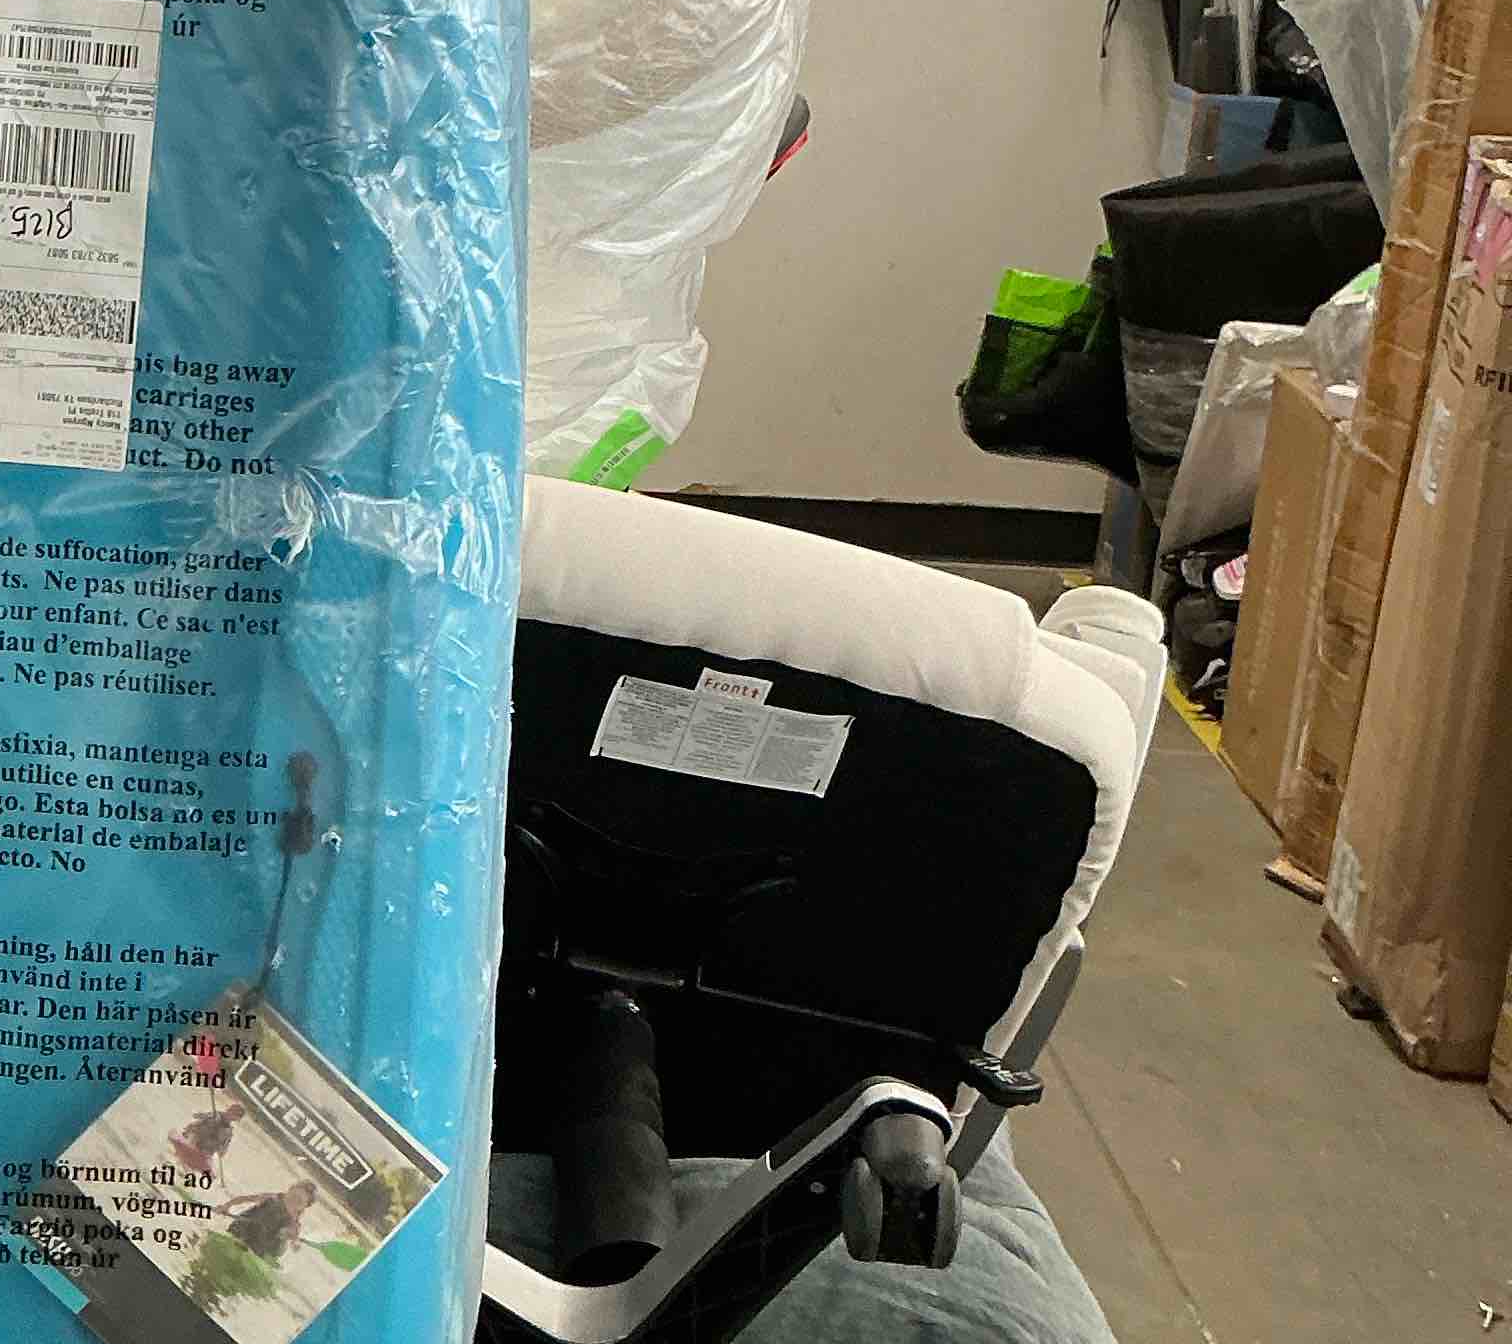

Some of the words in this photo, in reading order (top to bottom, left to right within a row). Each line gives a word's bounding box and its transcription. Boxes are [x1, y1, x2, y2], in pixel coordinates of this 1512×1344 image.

[173, 16, 200, 38] úr
[10, 201, 74, 240] B125
[228, 364, 296, 387] away
[136, 387, 254, 417] carriages
[184, 419, 253, 444] other
[35, 538, 177, 570] suffocation,
[134, 580, 217, 602] utiliser
[44, 604, 128, 628] enfant.
[103, 671, 216, 698] réutiliser.
[1, 763, 77, 789] utilice
[123, 776, 204, 800] cunas,
[250, 1072, 358, 1175] LIFETIME
[113, 1196, 212, 1220] vögnum
